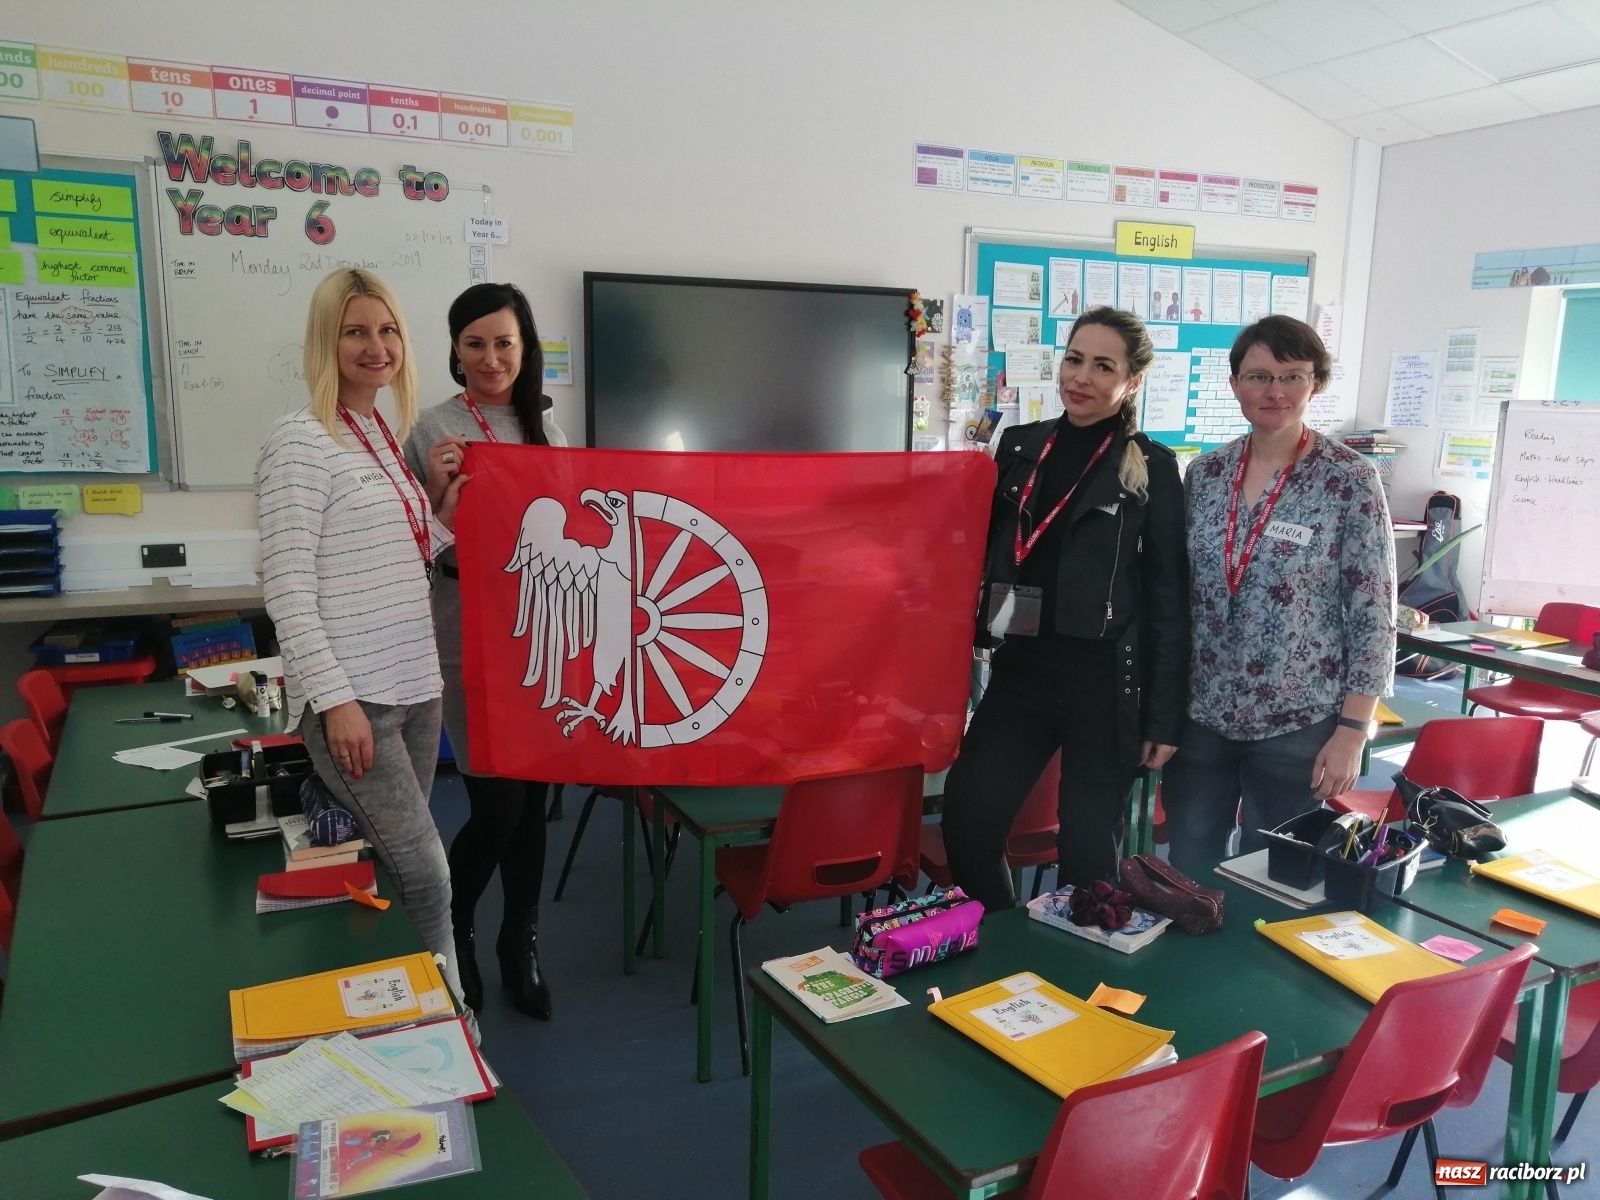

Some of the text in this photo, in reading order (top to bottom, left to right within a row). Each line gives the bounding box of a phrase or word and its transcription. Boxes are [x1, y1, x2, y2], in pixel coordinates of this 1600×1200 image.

[0, 53, 32, 66] nds
[48, 55, 119, 76] hundreds
[150, 67, 192, 87] tens
[229, 76, 276, 94] ones
[67, 80, 104, 101] 100
[162, 91, 184, 107] 10
[302, 86, 361, 102] decimal point
[249, 98, 258, 115] 1
[390, 96, 420, 107] tenths
[454, 103, 496, 115] hundredths
[392, 113, 418, 131] 0.1
[458, 121, 492, 138] 0.01
[521, 128, 564, 144] 0.001
[157, 131, 450, 202] Welcome to
[1030, 160, 1054, 168] PRONOUN
[50, 190, 102, 212] simplify
[166, 187, 337, 245] Year 6
[471, 218, 502, 230] Today in
[50, 228, 114, 244] equivalent
[472, 230, 488, 240] Year
[1134, 230, 1178, 252] English
[41, 261, 128, 277] highest common
[70, 272, 99, 282] factor
[231, 250, 291, 297] Monday
[300, 254, 322, 273] 2nd
[392, 251, 422, 272] 2019
[16, 288, 120, 310] Equivalent fractions
[13, 312, 38, 321] have
[45, 311, 62, 320] the
[106, 324, 122, 332] 213
[1150, 330, 1172, 341] PORTS
[176, 340, 191, 348] TIME
[178, 347, 198, 356] LUNCH
[18, 363, 32, 376] To
[44, 364, 106, 380] SIMPLIFY
[12, 410, 40, 421] highest
[350, 422, 366, 443] VISITOR
[380, 424, 394, 443] VISITOR
[1524, 428, 1556, 445] Reading
[395, 452, 409, 471] VISITOR
[1520, 452, 1541, 462] Maths
[360, 472, 386, 486] ANIELA
[1273, 474, 1287, 494] VISITOR
[1512, 494, 1538, 506] Science
[1260, 503, 1272, 524] VISITOR
[408, 512, 419, 534] VISITOR
[1026, 530, 1041, 549] VISITOR
[1269, 525, 1302, 542] MARIA
[1245, 533, 1258, 556] VISITOR
[1233, 564, 1246, 587] VISITOR
[1316, 930, 1354, 942] English
[388, 978, 406, 1002] English
[812, 980, 836, 992] THE
[820, 982, 871, 1002] SPAGHETTI
[832, 991, 868, 1006] TANGLE
[992, 998, 1032, 1018] English
